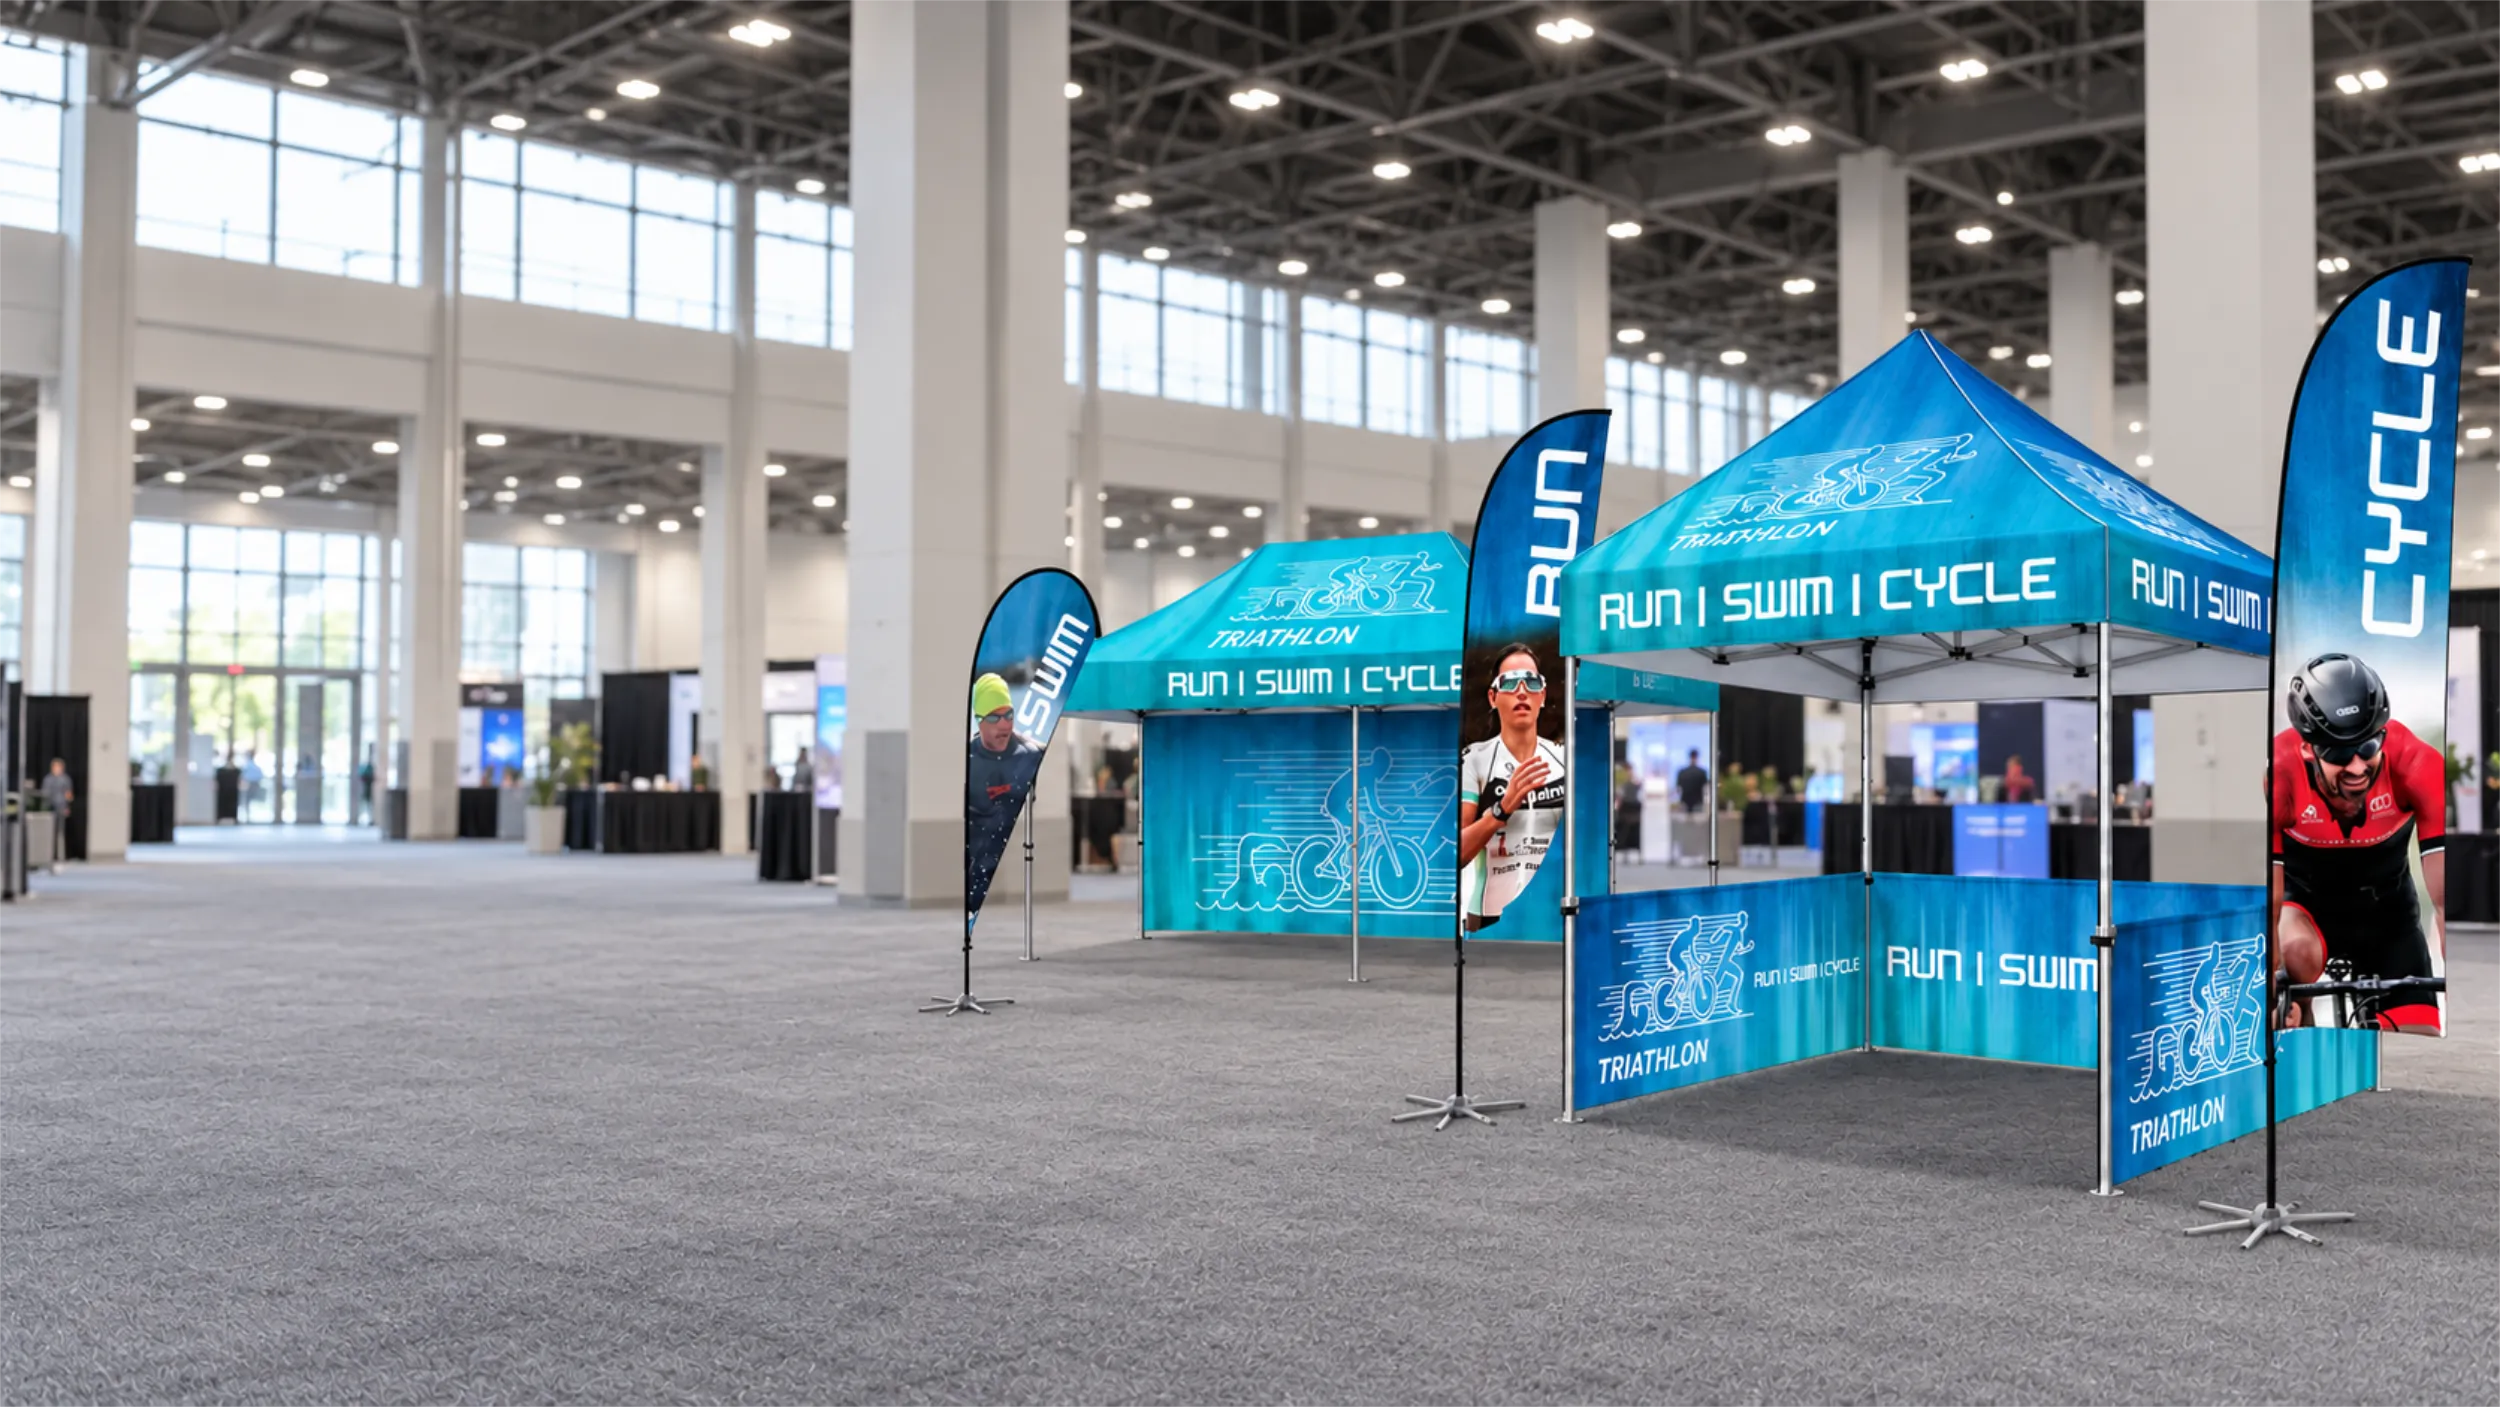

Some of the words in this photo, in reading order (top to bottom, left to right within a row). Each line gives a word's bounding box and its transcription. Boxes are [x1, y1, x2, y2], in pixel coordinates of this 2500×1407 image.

[2361, 299, 2441, 638] CYCLE
[1525, 448, 1588, 618] RUN
[1669, 520, 1838, 551] TRIATHLON
[1600, 589, 1682, 630] RUN
[1724, 575, 1834, 622] SWIM
[1879, 557, 2057, 611] CYCLE
[2132, 558, 2185, 611] RUN
[2207, 580, 2261, 631] SWIM
[1208, 624, 1360, 649] TRIATHLON
[1017, 613, 1090, 736] SWIM
[1168, 671, 1228, 697] RUN
[1256, 667, 1332, 695] SWIM
[1362, 664, 1462, 692] CYCLE
[1754, 969, 1781, 988] RUN
[1790, 963, 1818, 983] SWIM
[1824, 957, 1860, 977] CYCLE
[1887, 945, 1963, 982] RUN
[2000, 953, 2097, 992] SWIM
[1599, 1038, 1709, 1084] TRIATHLON
[2130, 1094, 2225, 1154] TRIATHLON
